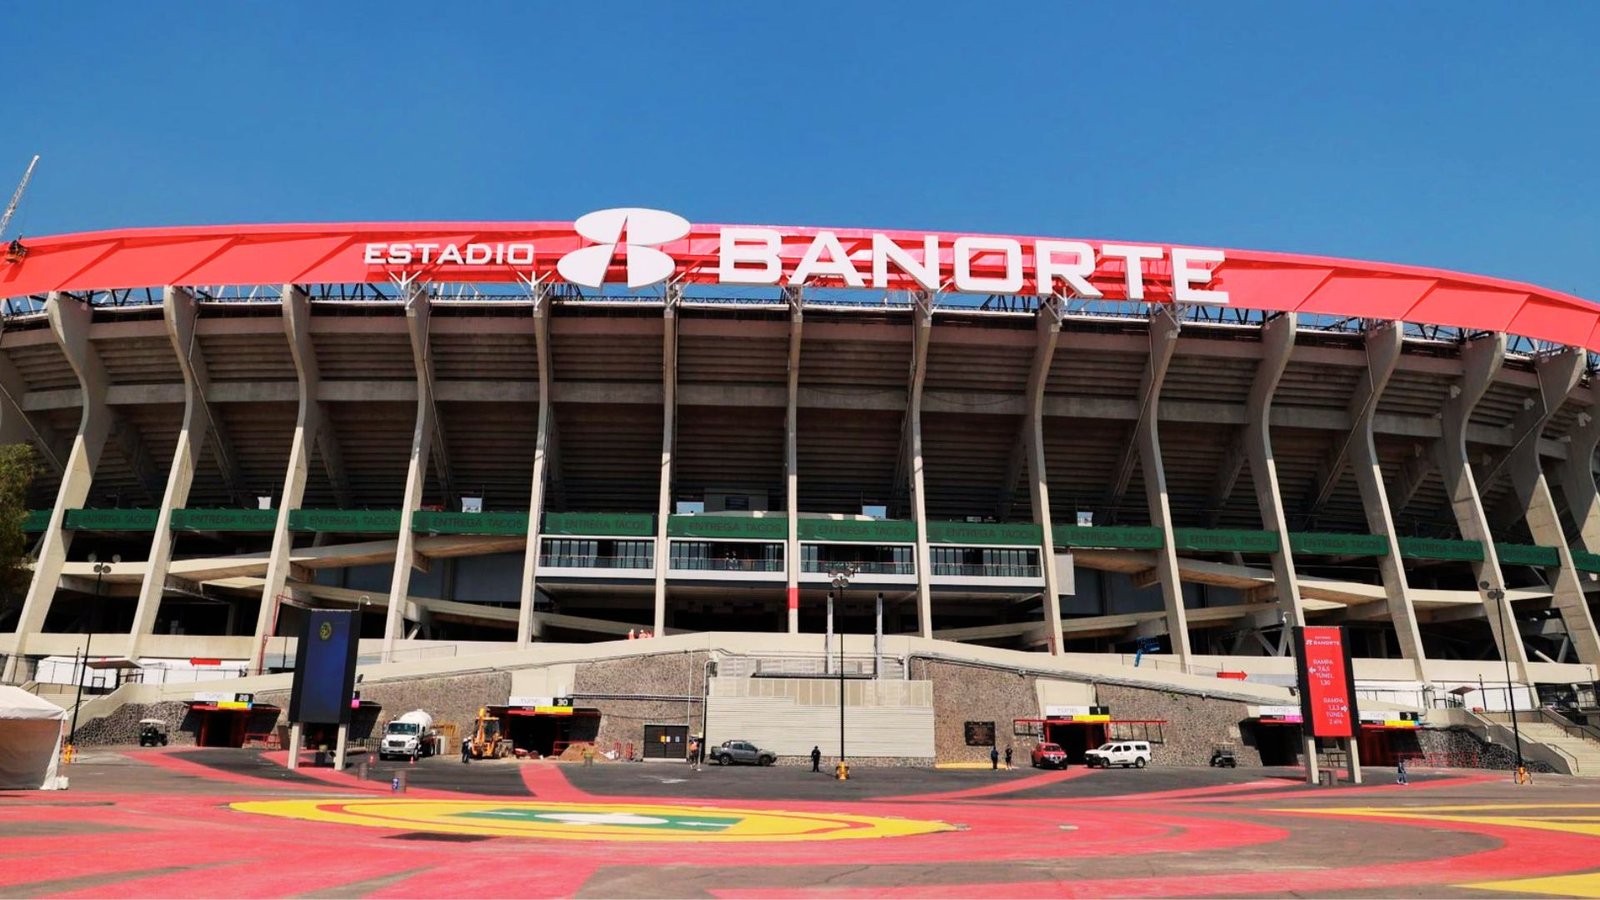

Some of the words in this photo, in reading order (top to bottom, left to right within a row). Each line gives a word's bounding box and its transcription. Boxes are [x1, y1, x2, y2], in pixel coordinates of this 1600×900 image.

[363, 242, 536, 266] ESTADIO
[718, 227, 1230, 305] BANORTE
[564, 518, 611, 530] ENTREGA
[615, 519, 646, 531] TACOS
[688, 521, 740, 532] ENTREGA
[745, 522, 783, 533] TACOS
[818, 525, 869, 536] ENTREGA
